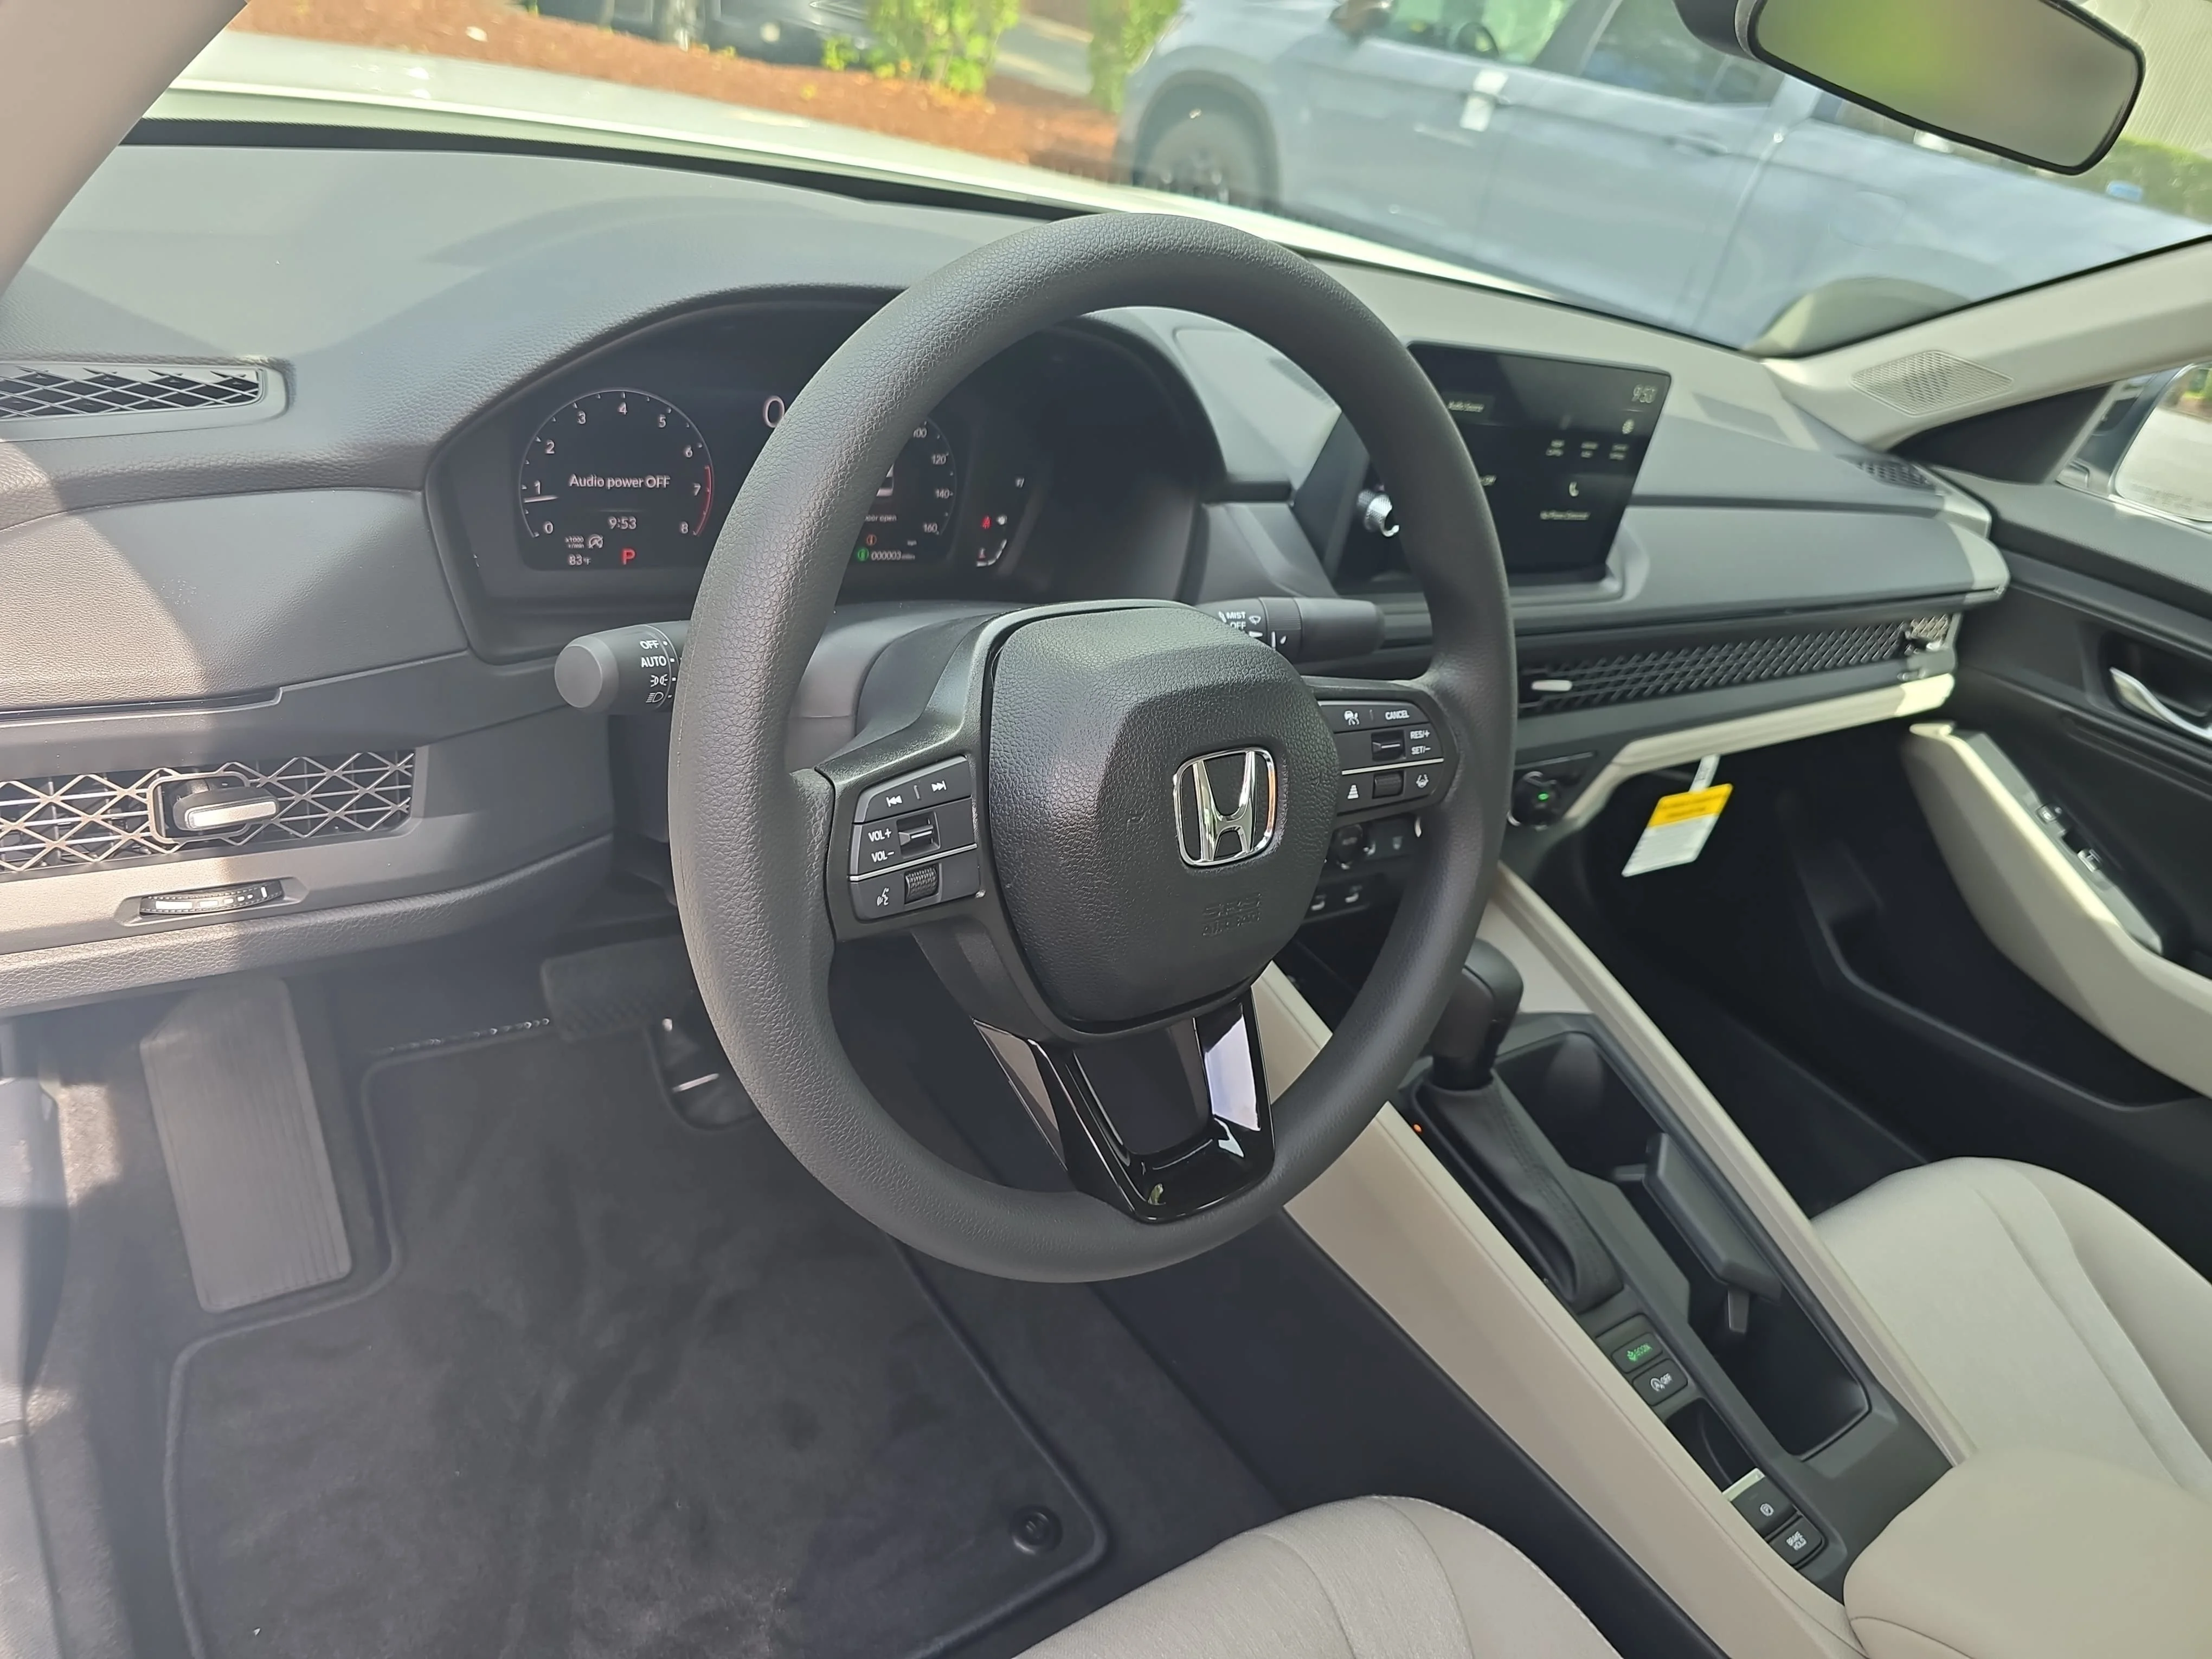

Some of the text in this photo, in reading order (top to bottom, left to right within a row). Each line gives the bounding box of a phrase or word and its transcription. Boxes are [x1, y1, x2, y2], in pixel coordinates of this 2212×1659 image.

[619, 402, 627, 415] 4
[763, 395, 785, 428] 0
[577, 411, 587, 425] 3
[658, 414, 667, 428] 5
[545, 440, 555, 454] 2
[684, 445, 693, 458] 6
[931, 454, 946, 465] 120
[534, 480, 541, 494] 1
[569, 473, 671, 489] Audio power OFF
[693, 483, 702, 496] 7
[935, 488, 950, 499] 140
[544, 520, 554, 533] 0
[608, 516, 638, 529] 9:53
[679, 522, 689, 534] 8
[923, 522, 938, 533] 160
[621, 548, 636, 565] P
[871, 550, 902, 561] 000003
[1226, 611, 1246, 620] MIST
[639, 640, 659, 650] OFF
[641, 655, 667, 668] AUTO
[1385, 710, 1410, 720] CANCEL
